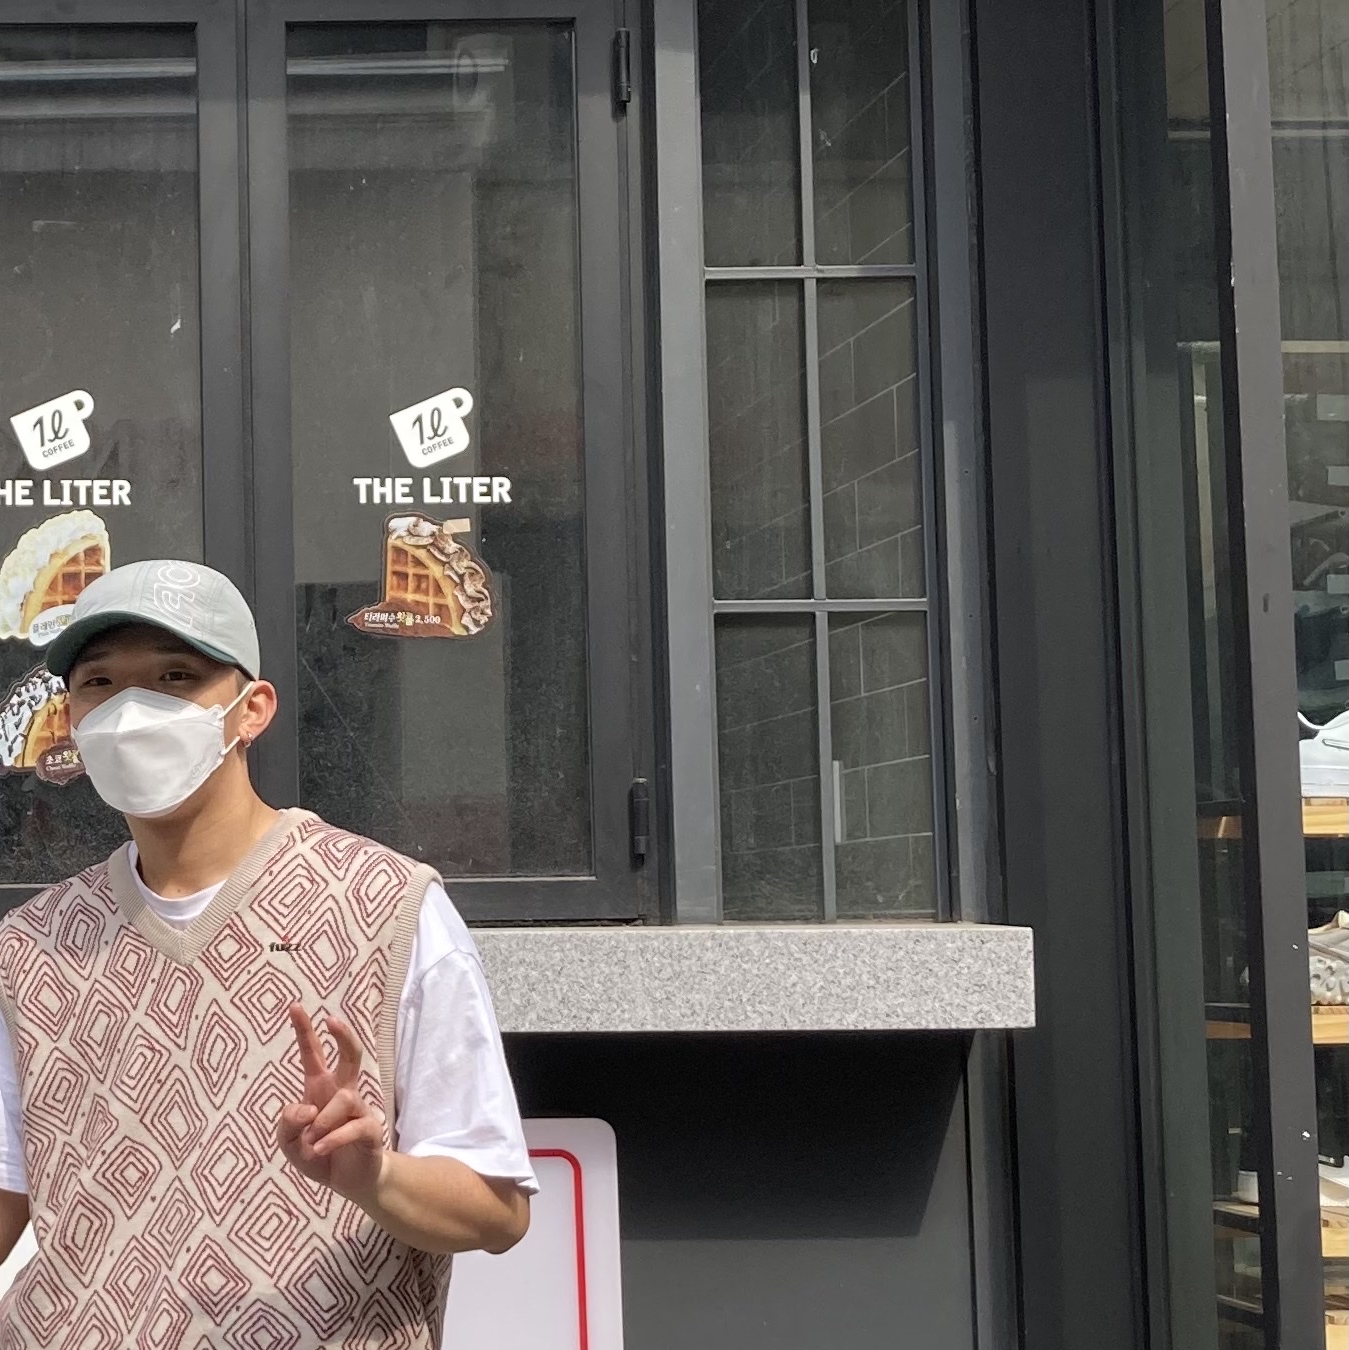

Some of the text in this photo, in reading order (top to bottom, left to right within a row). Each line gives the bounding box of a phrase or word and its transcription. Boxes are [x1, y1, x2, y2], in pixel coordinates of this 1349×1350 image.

[42, 439, 75, 458] COFFEE
[421, 436, 454, 456] COFFEE
[43, 479, 132, 506] LITER
[353, 476, 512, 504] THE LITER
[415, 614, 441, 624] 2,500
